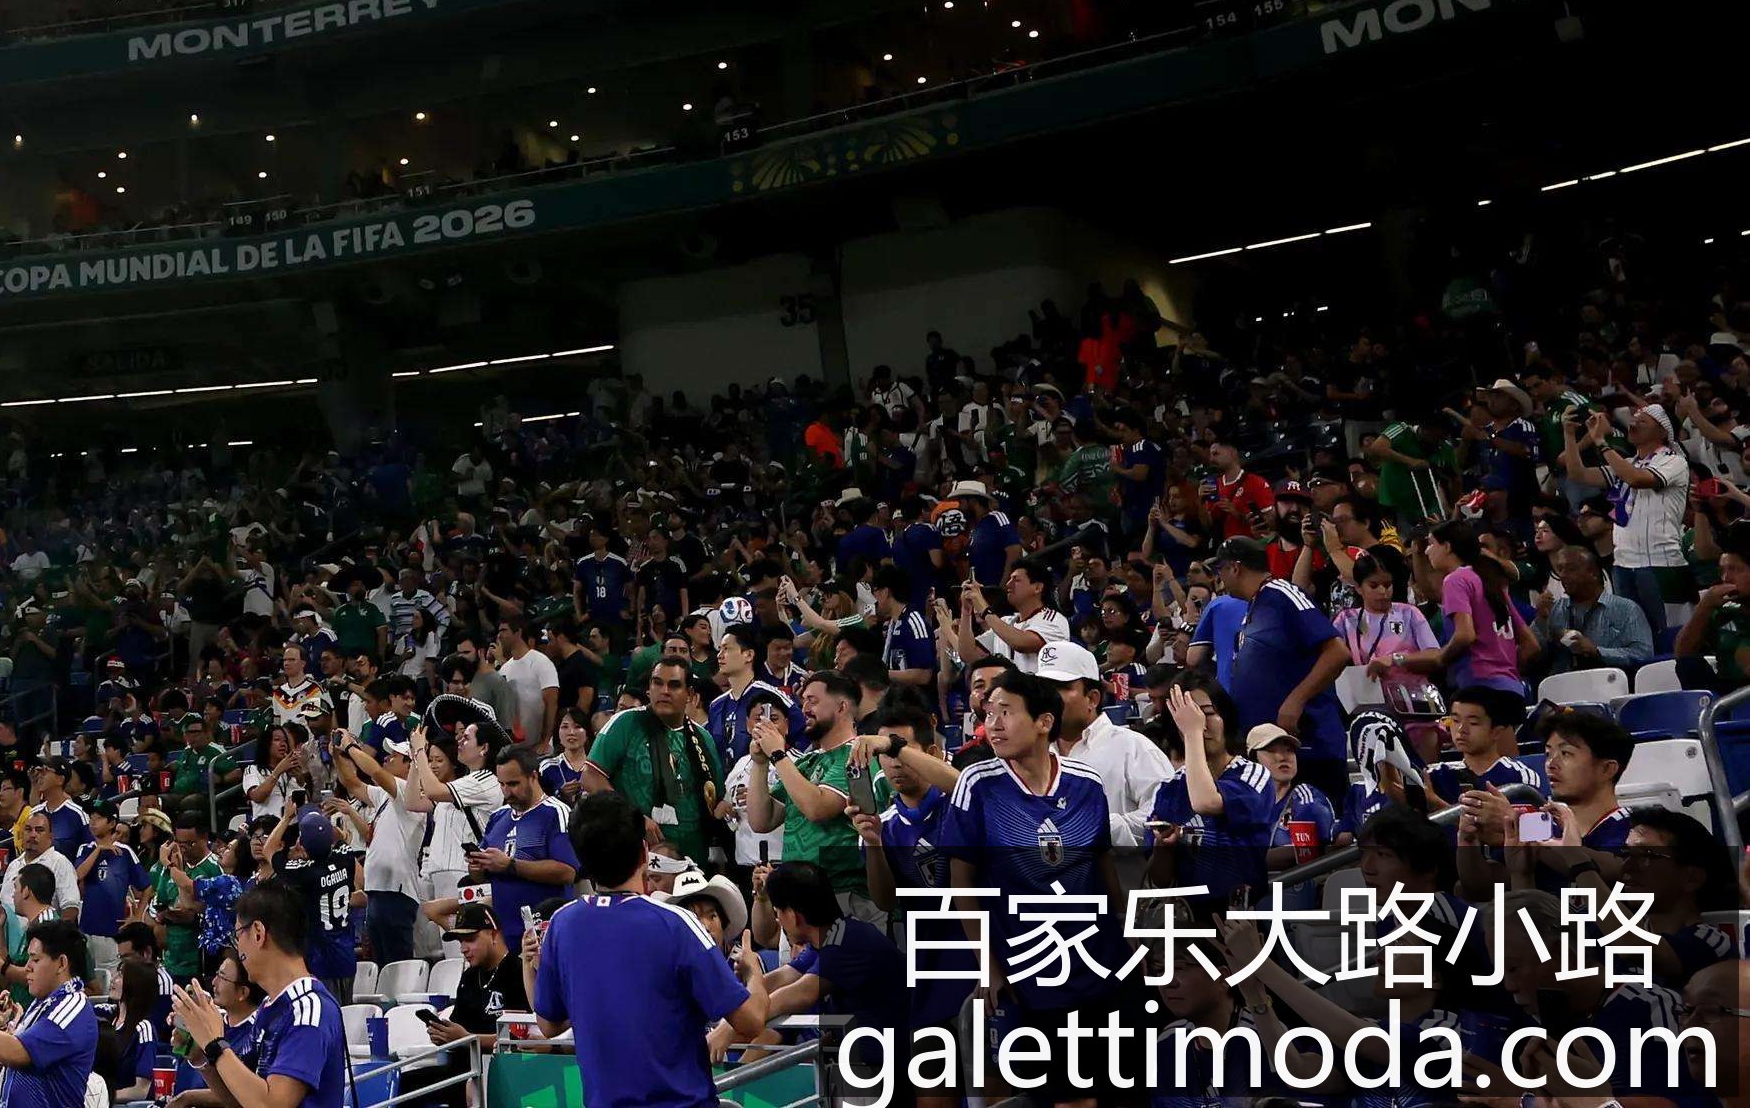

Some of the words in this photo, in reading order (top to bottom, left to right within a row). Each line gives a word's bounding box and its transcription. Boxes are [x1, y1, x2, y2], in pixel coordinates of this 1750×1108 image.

[1205, 12, 1238, 29] 154
[725, 127, 749, 142] 153
[79, 248, 229, 286] MUNDIAL
[236, 241, 279, 272] DE
[284, 234, 327, 265] LA
[332, 220, 405, 257] FIFA
[412, 199, 537, 244] 2026
[780, 293, 816, 326] 35
[596, 585, 607, 599] 18
[320, 867, 348, 888] OGAWA
[320, 885, 350, 931] 19
